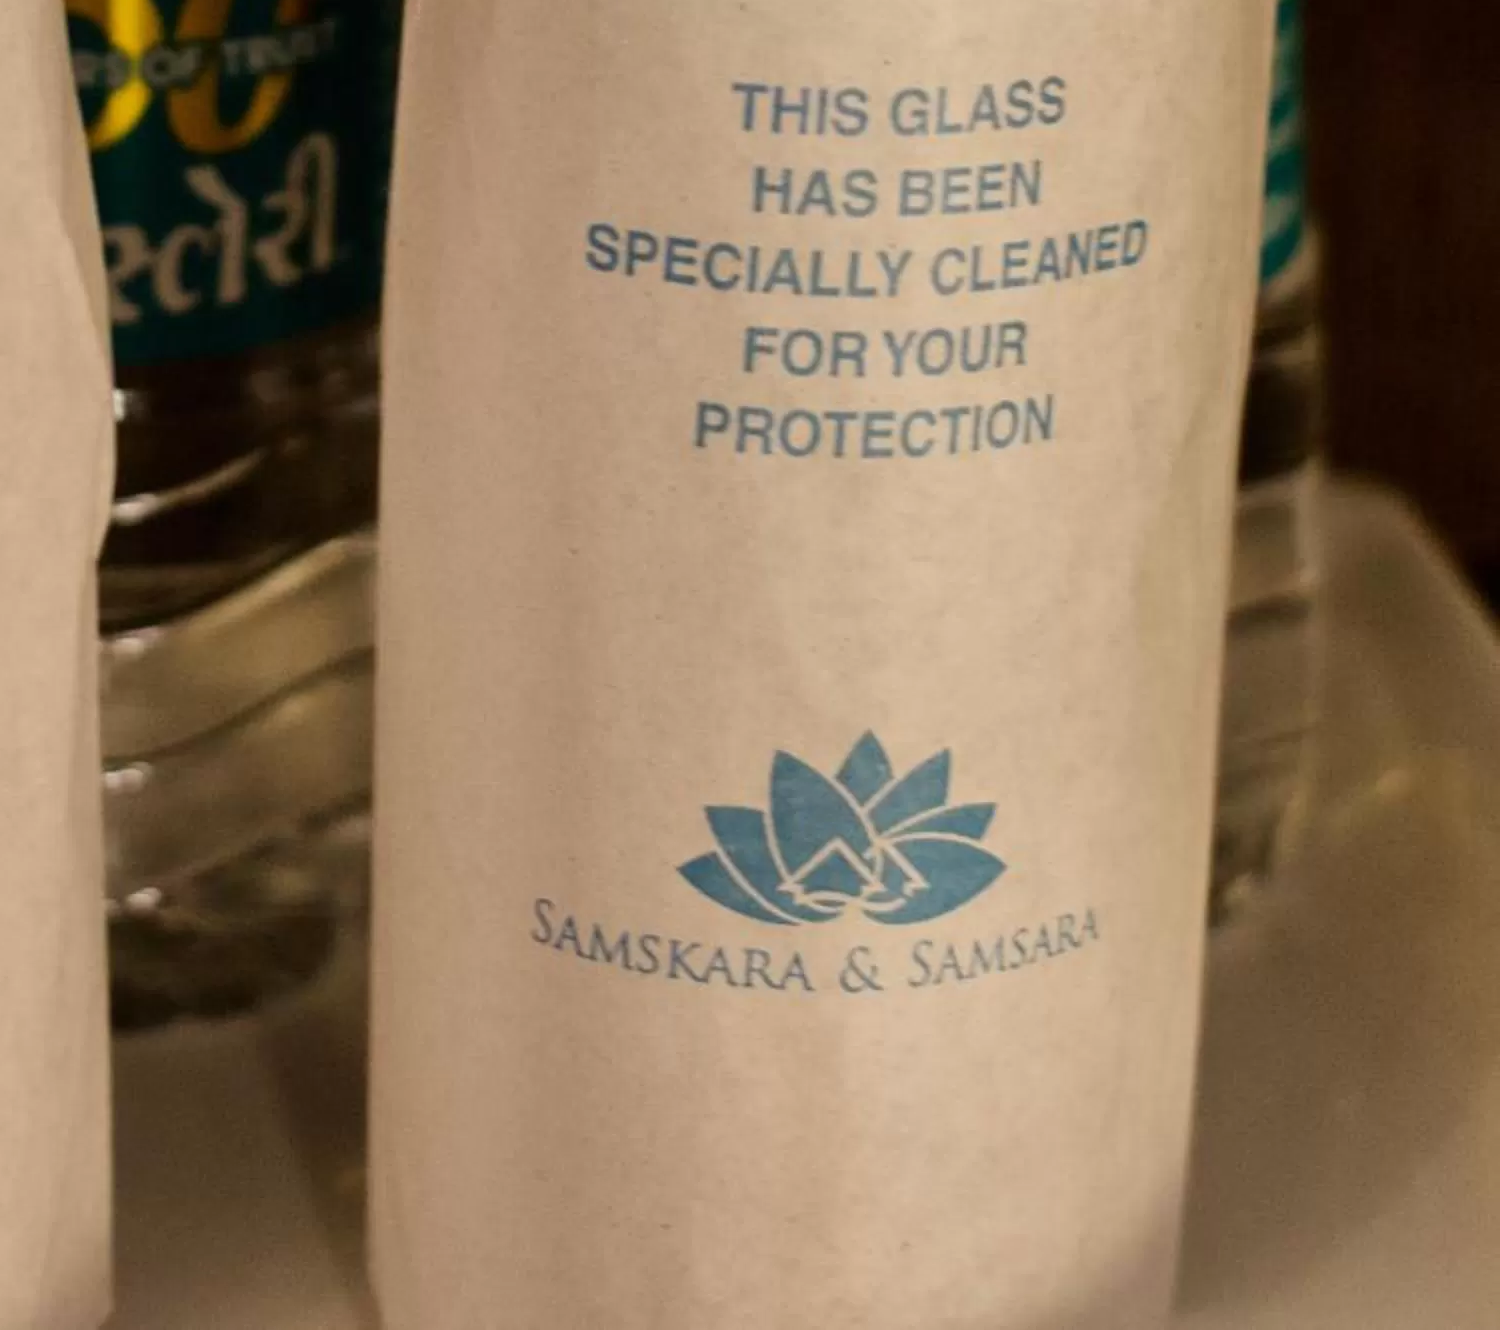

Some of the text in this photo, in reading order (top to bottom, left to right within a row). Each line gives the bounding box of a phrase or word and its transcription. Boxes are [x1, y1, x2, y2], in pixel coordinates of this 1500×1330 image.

[731, 75, 1067, 137] THIS GLASS
[751, 159, 1043, 218] HAS BEEN
[585, 219, 1149, 298] SPECIALLY CLEANED
[742, 320, 1028, 378] FOR YOUR
[694, 394, 1056, 460] PROTECTION
[530, 898, 1101, 994] SAMSKARA & SAMSARA
